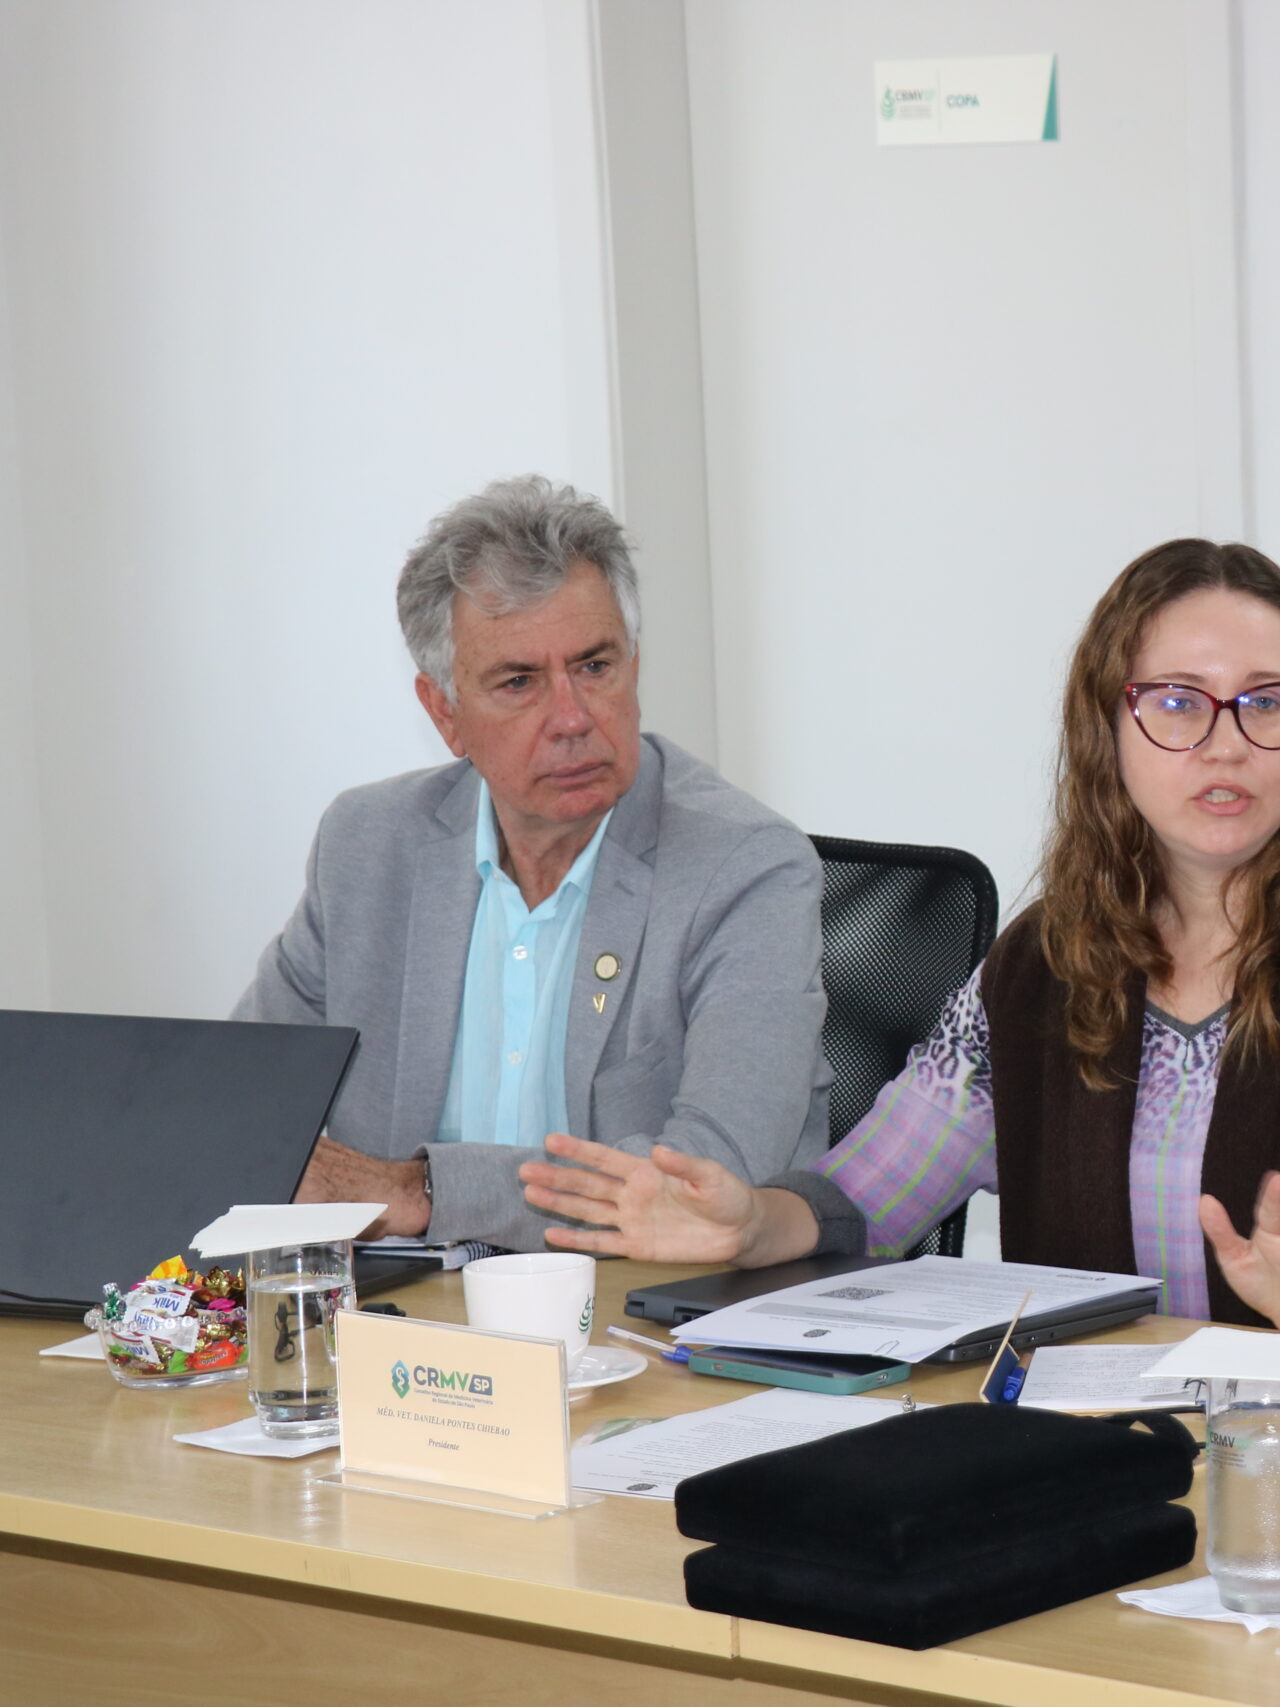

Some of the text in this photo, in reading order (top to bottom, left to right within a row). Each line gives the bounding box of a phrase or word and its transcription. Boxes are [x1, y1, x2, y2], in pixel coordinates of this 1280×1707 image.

[946, 95, 980, 108] COPA
[154, 1297, 181, 1312] Milk
[413, 1365, 469, 1391] CRMV
[397, 1410, 412, 1421] VET.
[414, 1413, 445, 1427] DANIELA
[447, 1418, 476, 1431] PONTES
[428, 1438, 460, 1451] Presidente
